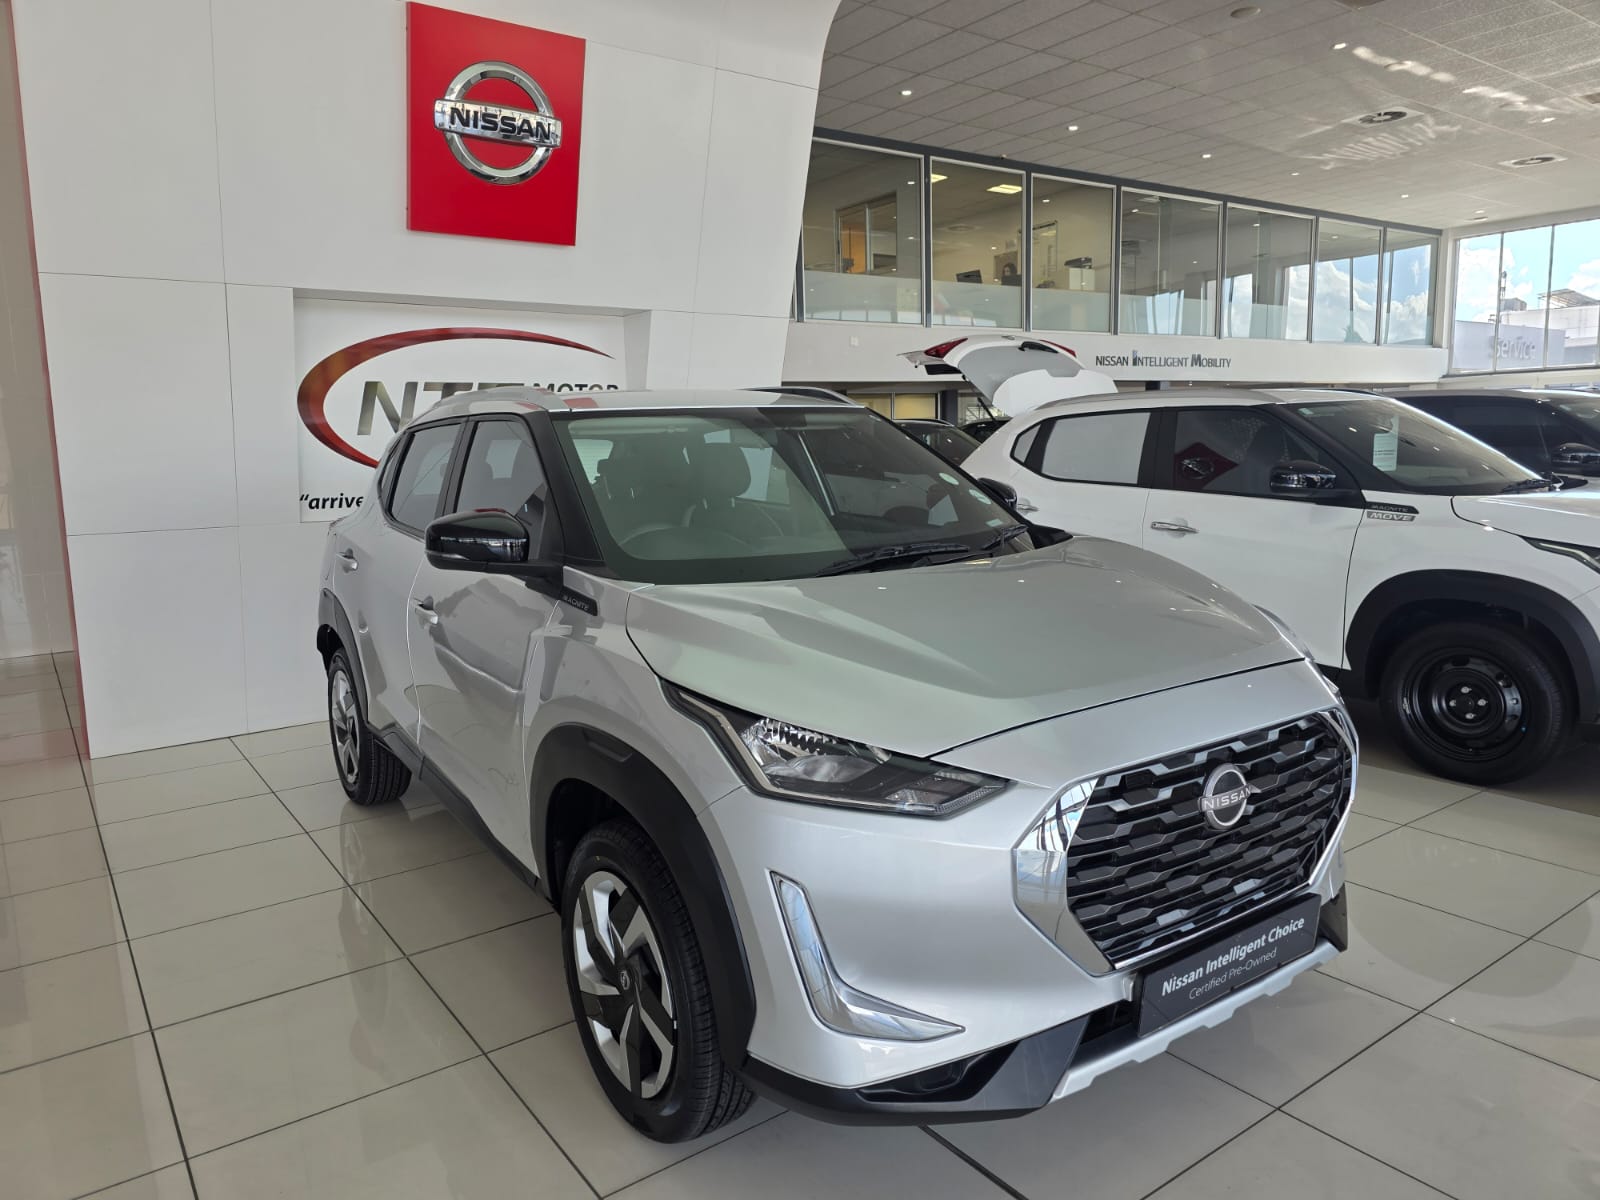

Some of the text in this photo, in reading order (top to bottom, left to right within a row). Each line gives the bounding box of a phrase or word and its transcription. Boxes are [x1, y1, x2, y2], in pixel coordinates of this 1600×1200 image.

[449, 106, 552, 142] NISSAN
[1095, 350, 1232, 368] NISSAN INTELLIGENT MOBILITY
[1370, 512, 1411, 521] MOVE
[1204, 786, 1251, 810] NISSAN
[1161, 917, 1305, 997] Nissan Intelligent Choice
[1188, 946, 1278, 1000] Certified Pre-Owned
